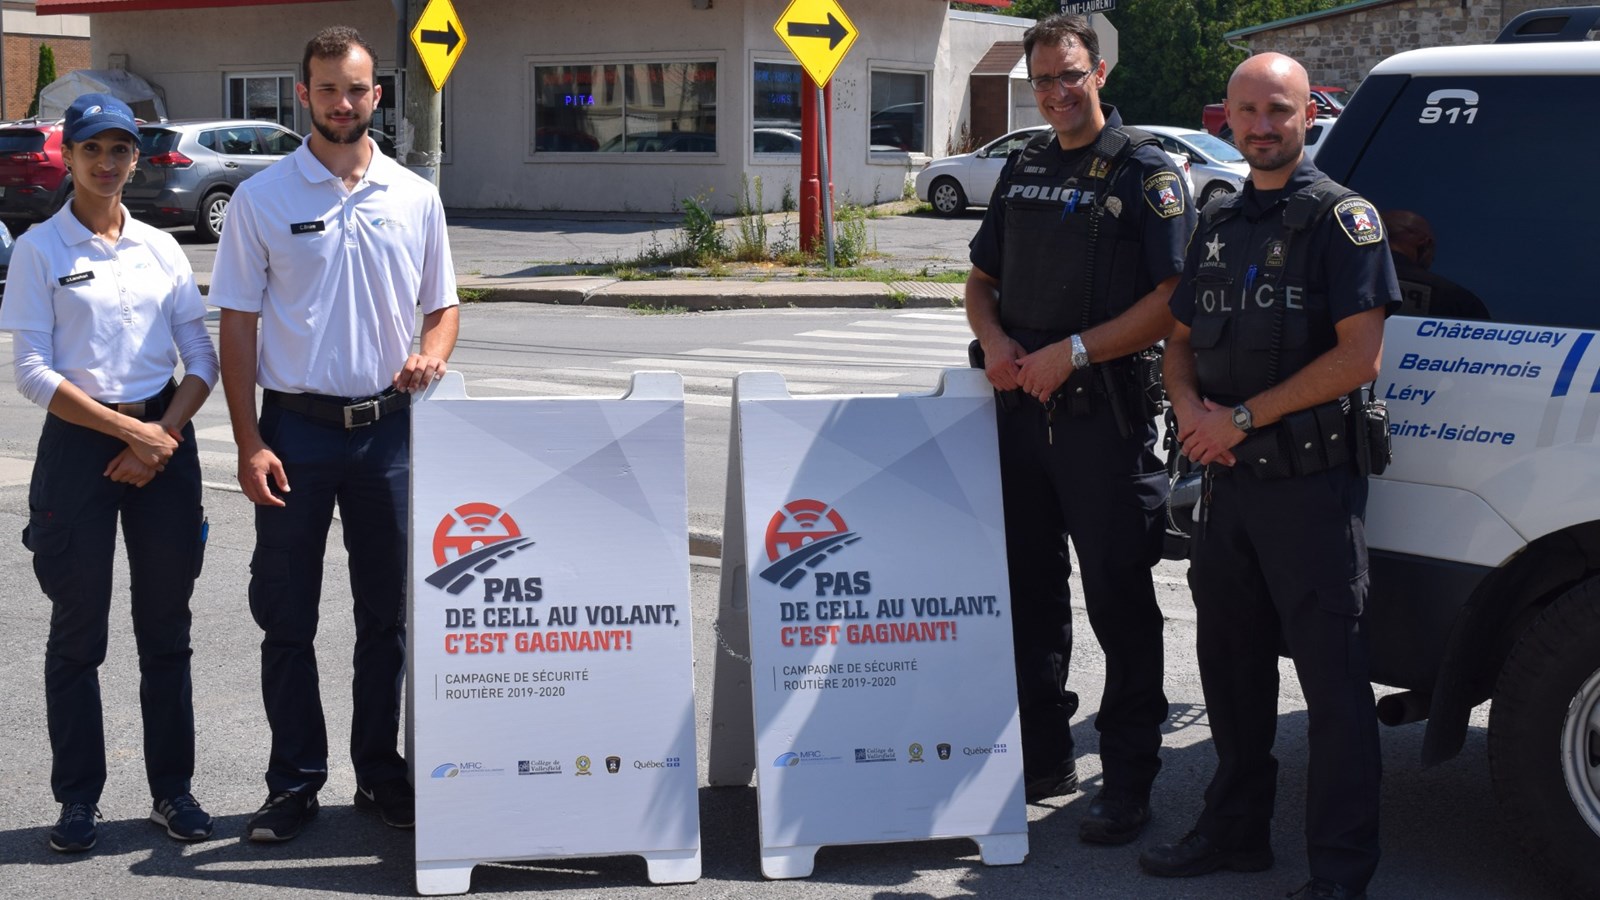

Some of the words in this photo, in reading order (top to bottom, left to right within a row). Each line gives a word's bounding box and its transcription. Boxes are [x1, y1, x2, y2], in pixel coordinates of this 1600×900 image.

[1061, 0, 1112, 14] SAINT-LAURENT
[564, 95, 595, 106] PITA
[1419, 107, 1478, 124] 911
[1007, 185, 1095, 204] POLICE
[1194, 284, 1303, 312] OLICE
[1416, 320, 1567, 347] Châteauguay
[1398, 353, 1542, 378] Beauharnois
[1385, 383, 1436, 405] Léry
[1389, 420, 1516, 445] aint-Isidore
[483, 577, 543, 602] PAS
[814, 571, 871, 596] PAS
[445, 608, 475, 628] DE
[483, 606, 539, 627] CELL
[547, 606, 577, 626] AU
[585, 604, 679, 627] VOLANT,
[780, 602, 809, 621] DE
[815, 600, 869, 620] CELL
[876, 599, 904, 618] AU
[912, 595, 1001, 617] VOLANT,
[445, 632, 508, 655] C'EST
[515, 630, 632, 652] GAGNANT!
[781, 625, 840, 647] C'EST
[846, 621, 957, 644] GAGNANT!
[445, 672, 510, 684] CAMPAGNE
[514, 671, 529, 683] DE
[532, 668, 589, 682] SÉCURITÉ
[783, 663, 843, 676] CAMPAGNE
[847, 662, 861, 674] DE
[864, 659, 918, 673] SÉCURITÉ
[446, 685, 504, 699] ROUTIÈRE
[507, 686, 565, 698] 2019-2020
[784, 677, 838, 690] ROUTIÈRE
[841, 676, 896, 688] 2019-2020
[800, 750, 822, 758] MRC
[963, 746, 993, 756] Québec
[460, 762, 482, 770] MRC
[633, 760, 665, 769] Québec
